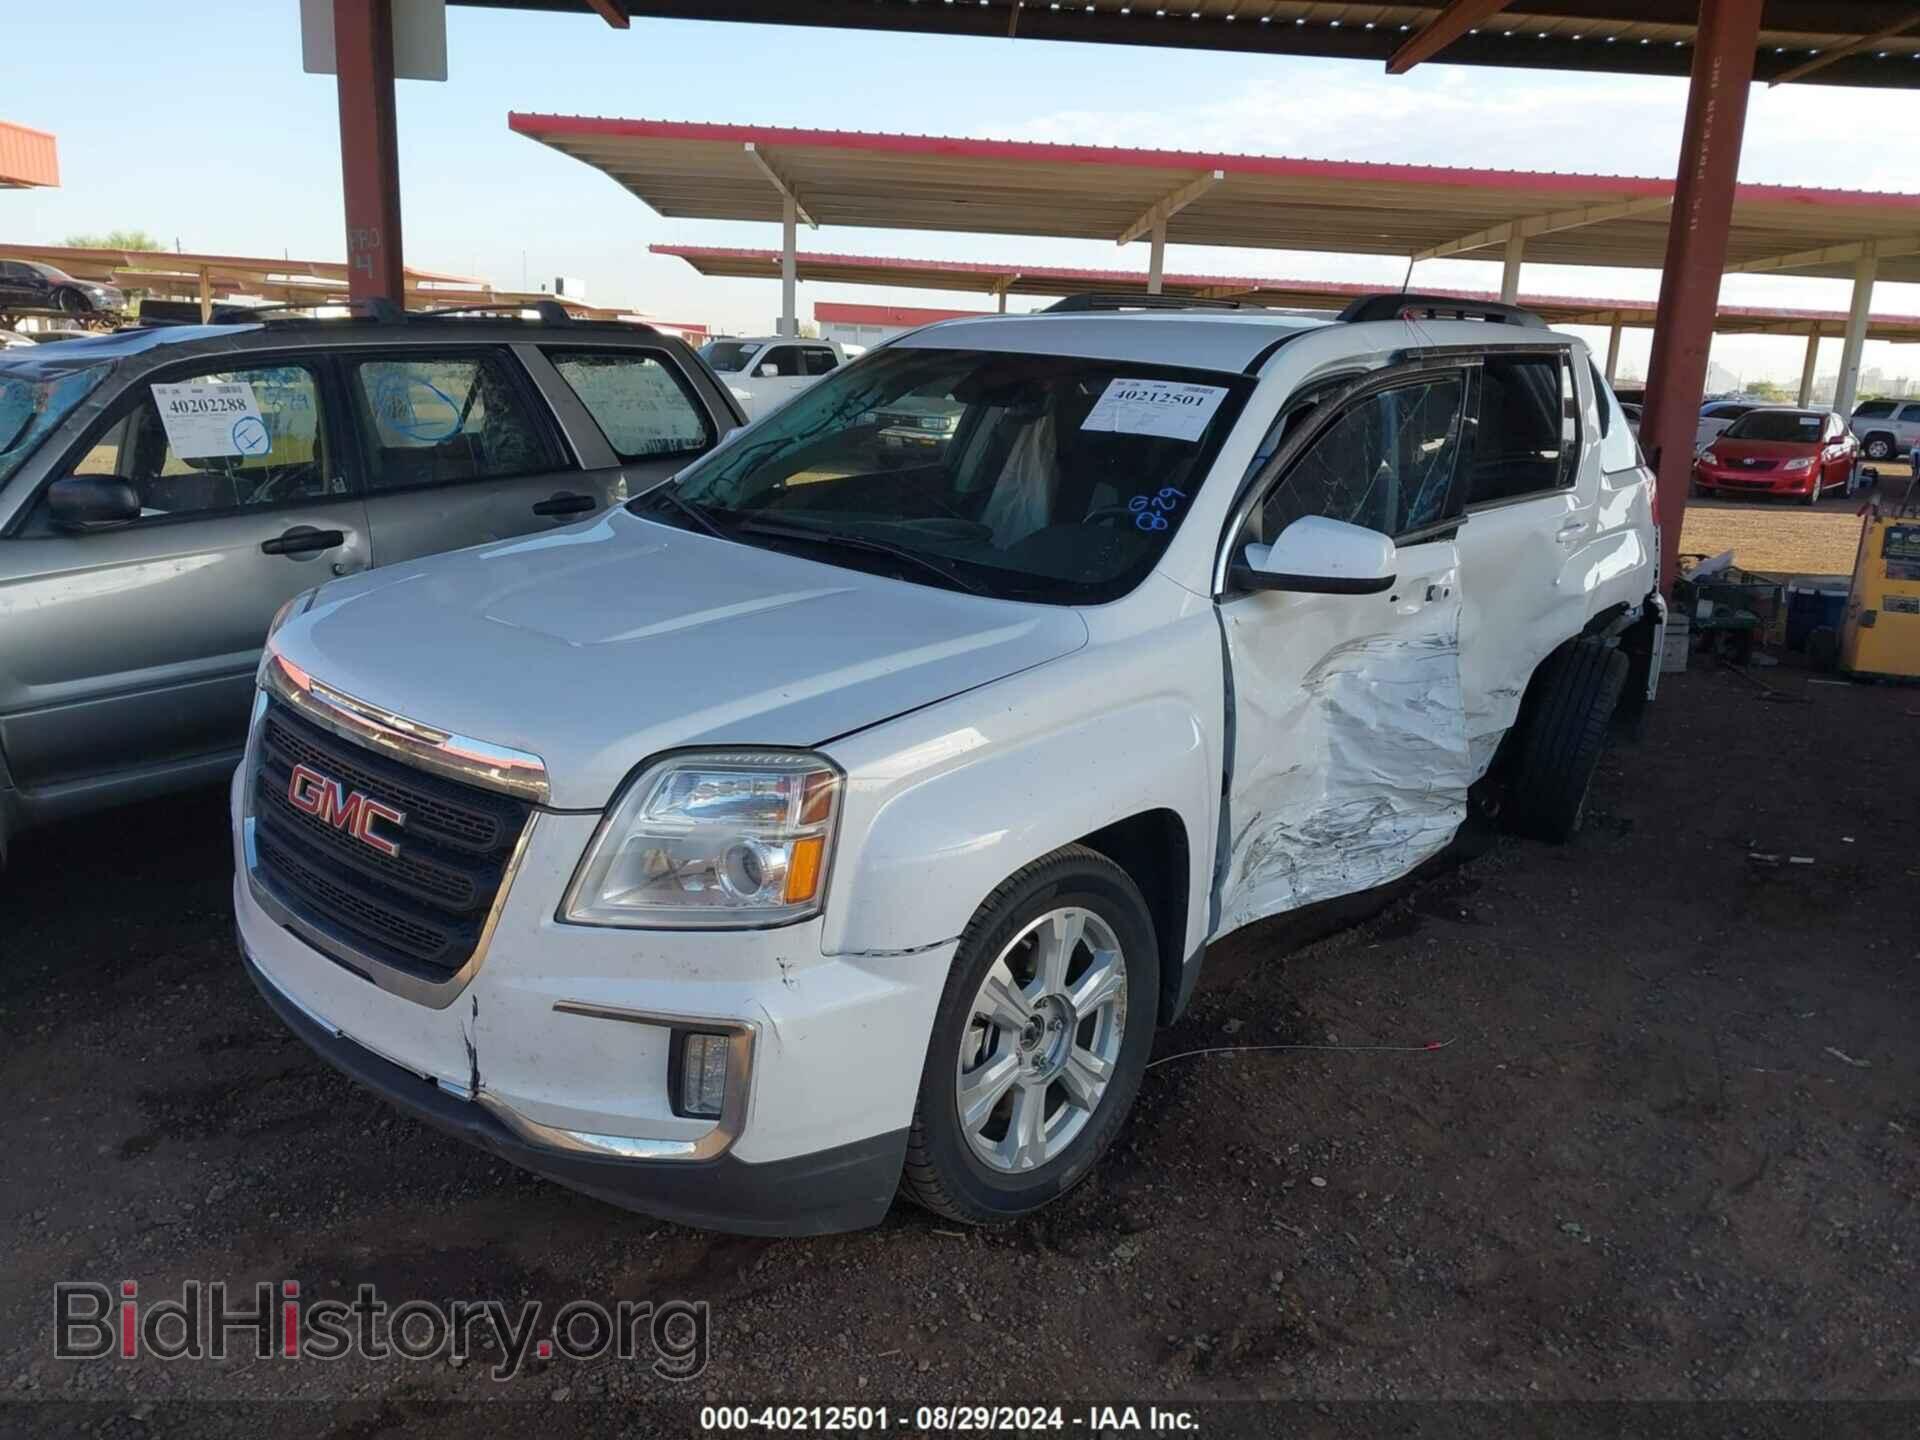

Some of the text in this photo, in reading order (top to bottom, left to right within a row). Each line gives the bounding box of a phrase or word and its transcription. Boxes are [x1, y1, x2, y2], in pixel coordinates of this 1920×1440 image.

[169, 398, 247, 413] 40202288
[1114, 389, 1204, 407] 40212501
[288, 763, 407, 858] GMC
